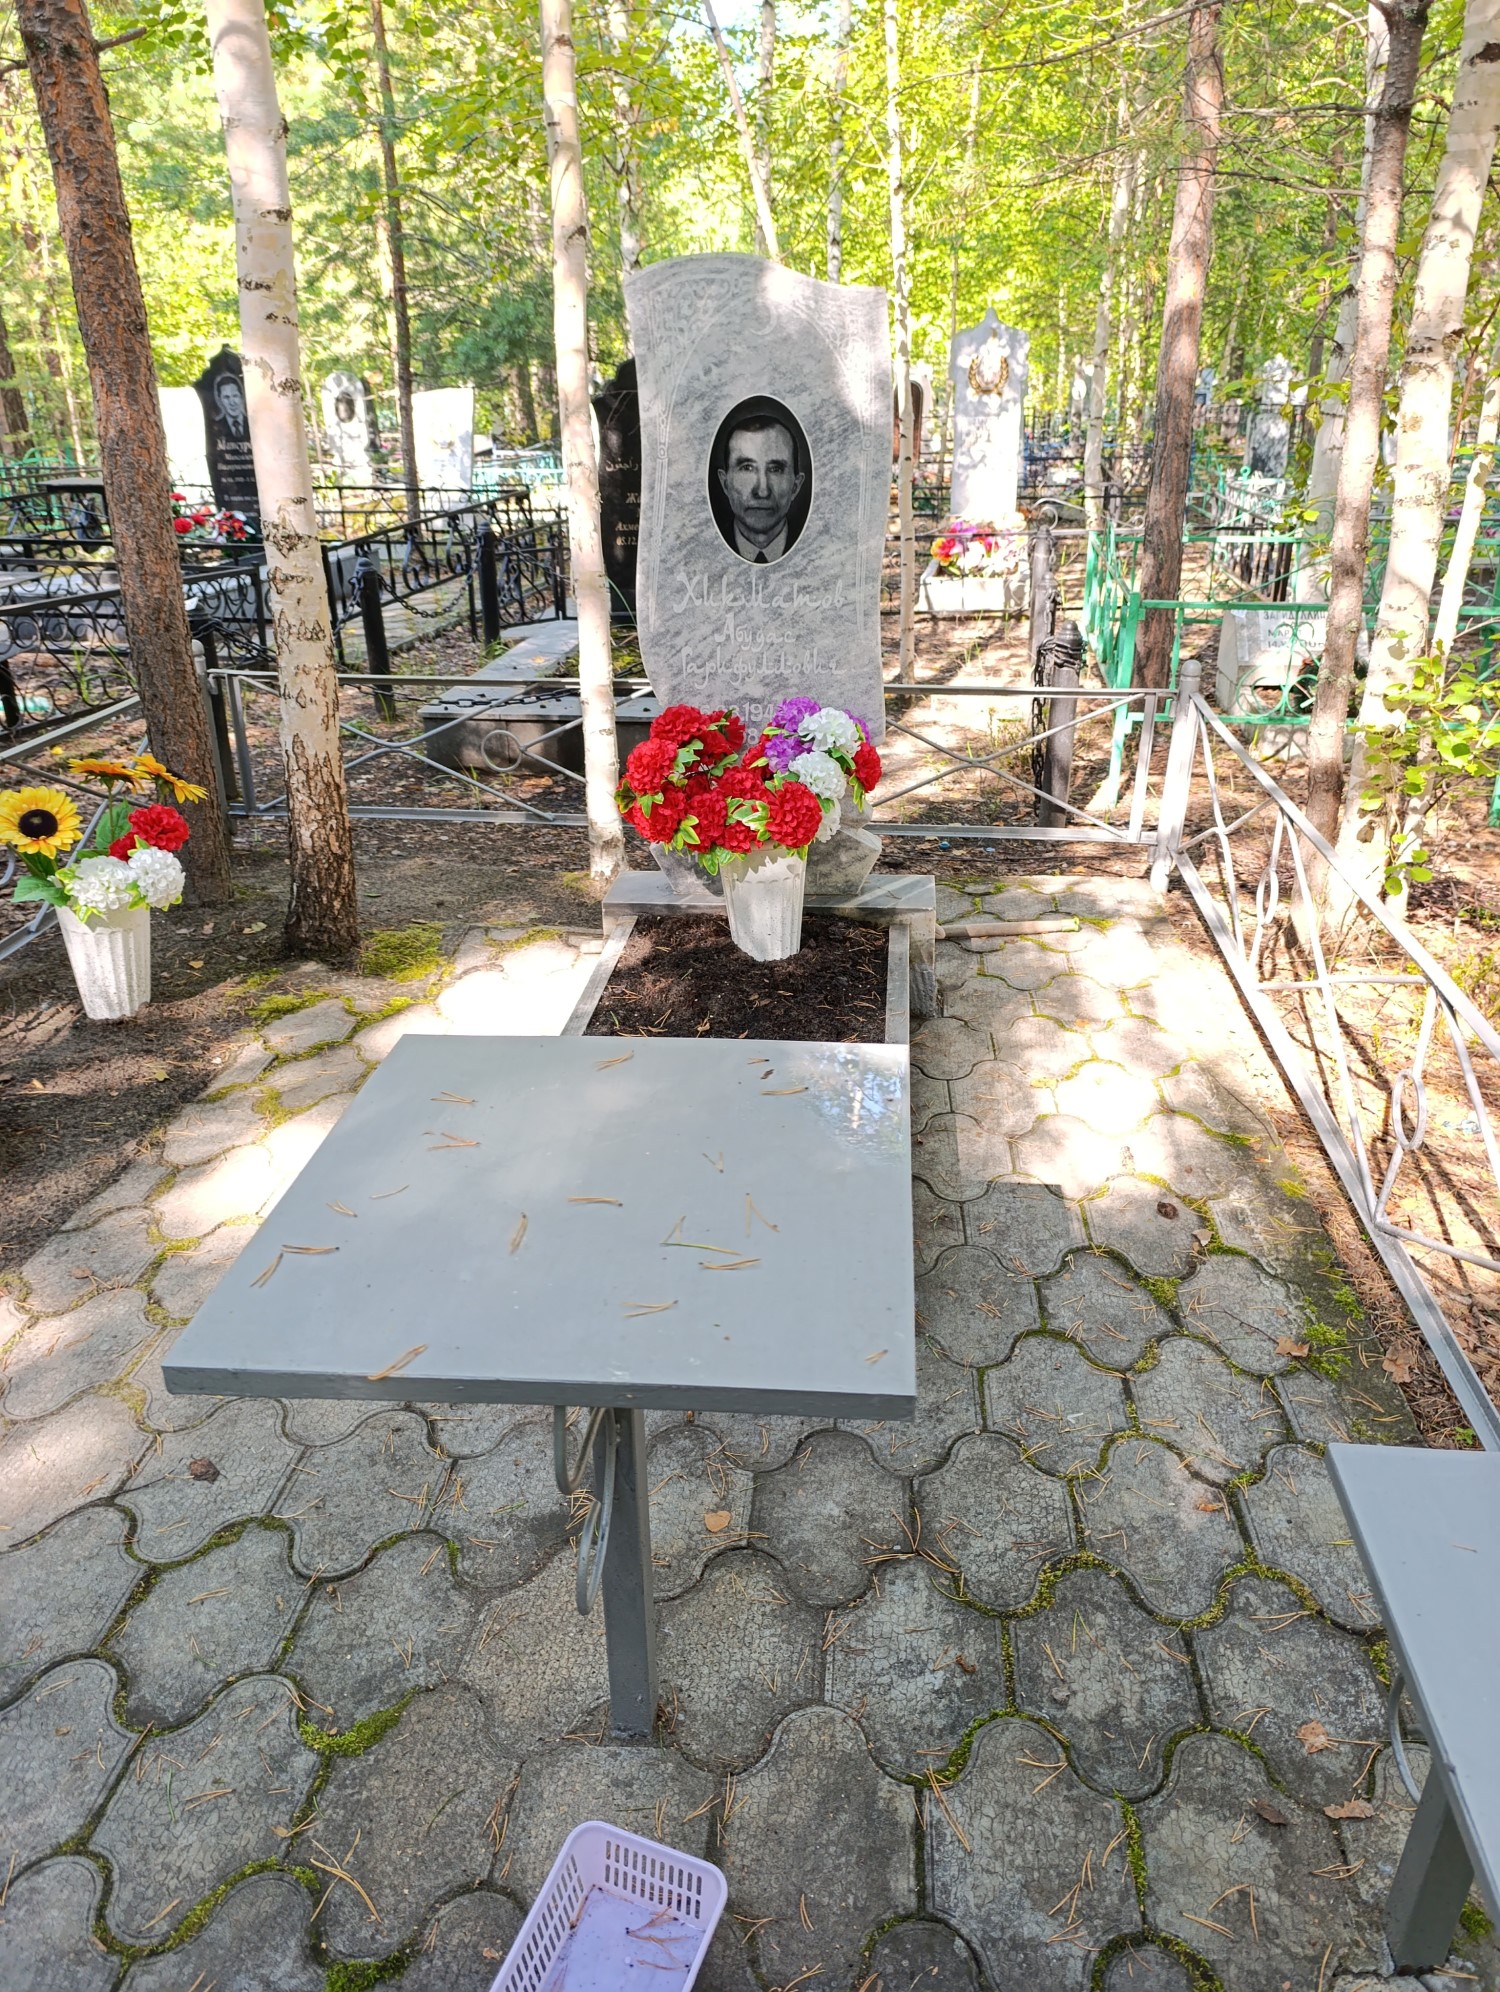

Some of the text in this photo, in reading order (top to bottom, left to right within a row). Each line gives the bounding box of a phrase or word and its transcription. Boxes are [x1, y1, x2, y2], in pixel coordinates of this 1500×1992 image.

[674, 572, 846, 613] Хикматов
[714, 612, 796, 651] Абудас
[681, 646, 847, 689] Гарифуллович
